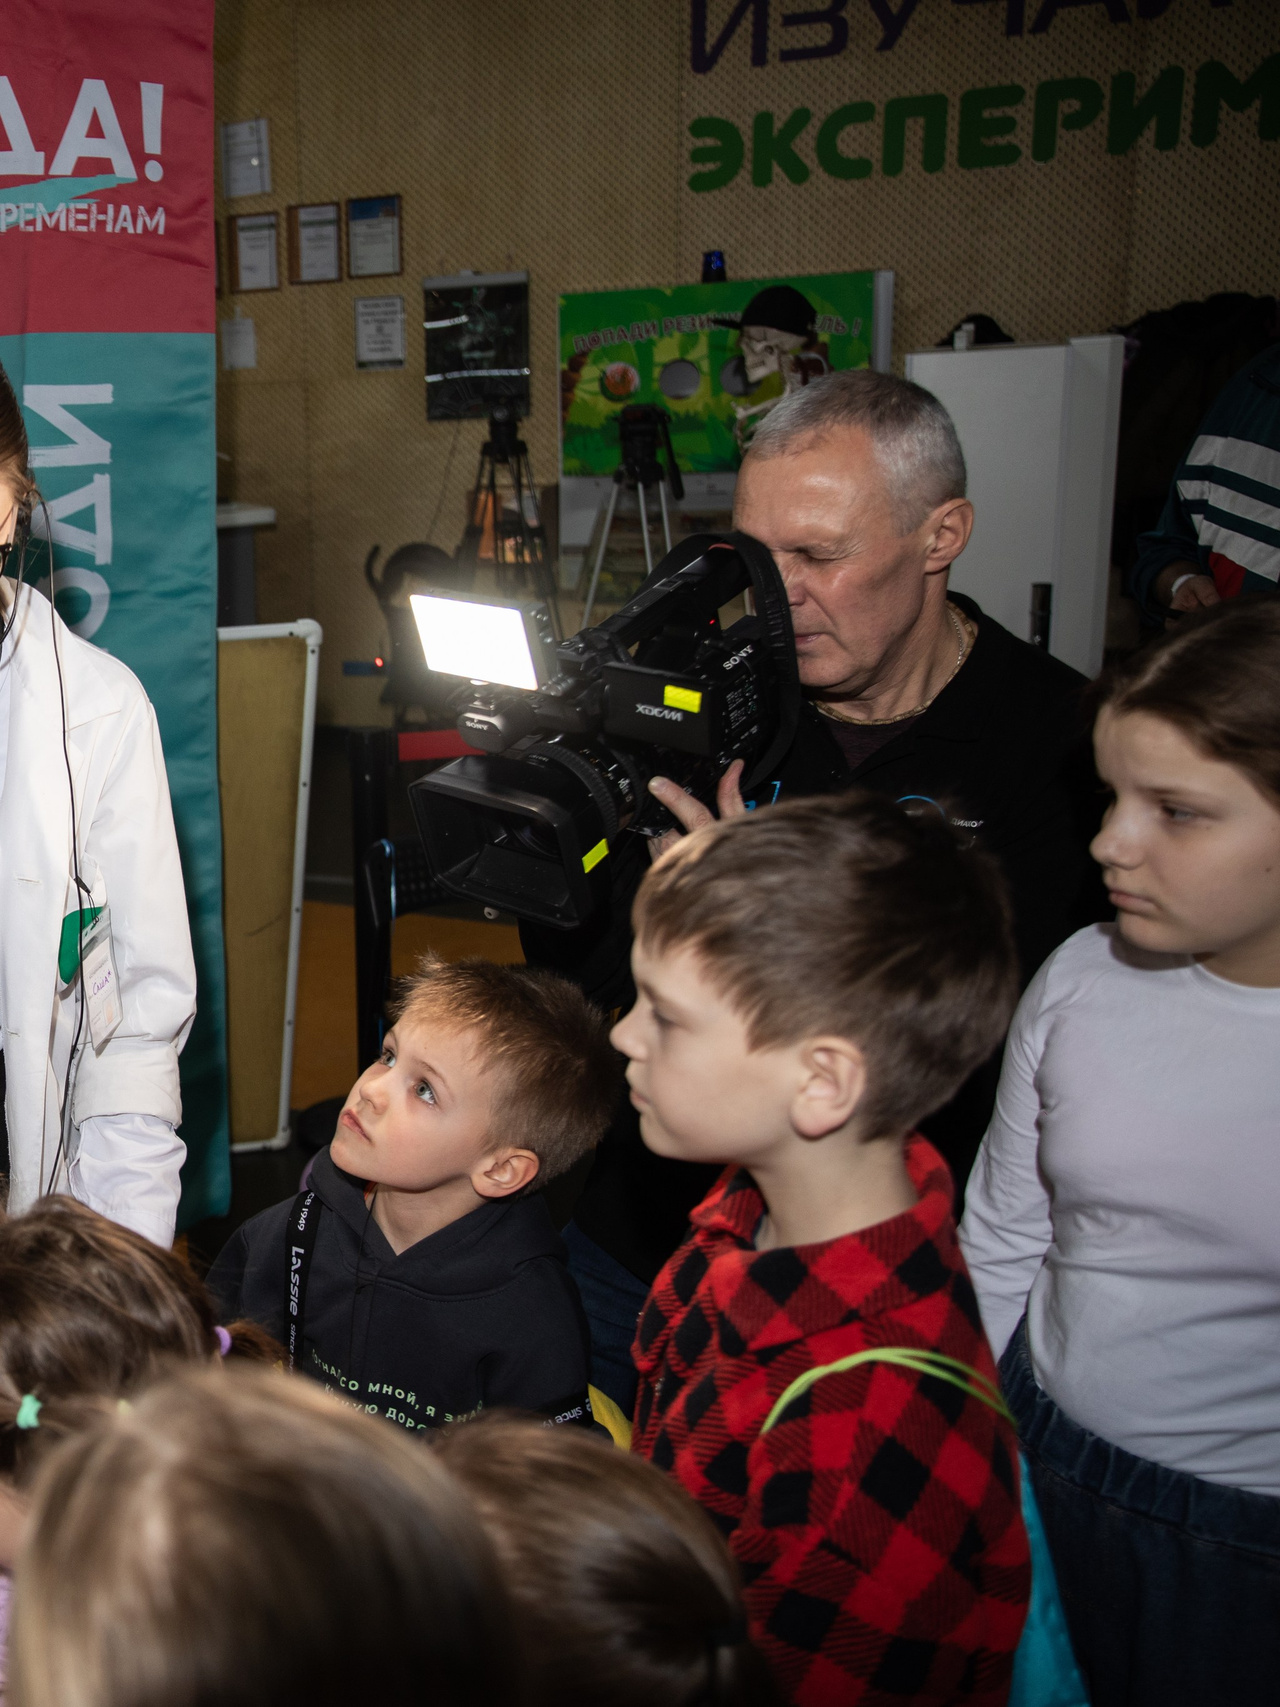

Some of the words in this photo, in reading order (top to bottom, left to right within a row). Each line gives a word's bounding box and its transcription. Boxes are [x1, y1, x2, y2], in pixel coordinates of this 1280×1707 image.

[573, 319, 659, 355] ПОПАДИ
[722, 644, 755, 671] SONY
[634, 702, 684, 722] XDCAM
[465, 720, 489, 731] SONY
[297, 1207, 309, 1232] 1949
[289, 1323, 297, 1354] since
[367, 1382, 420, 1411] МНОЙ,
[425, 1405, 436, 1418] Я
[554, 1406, 583, 1424] since
